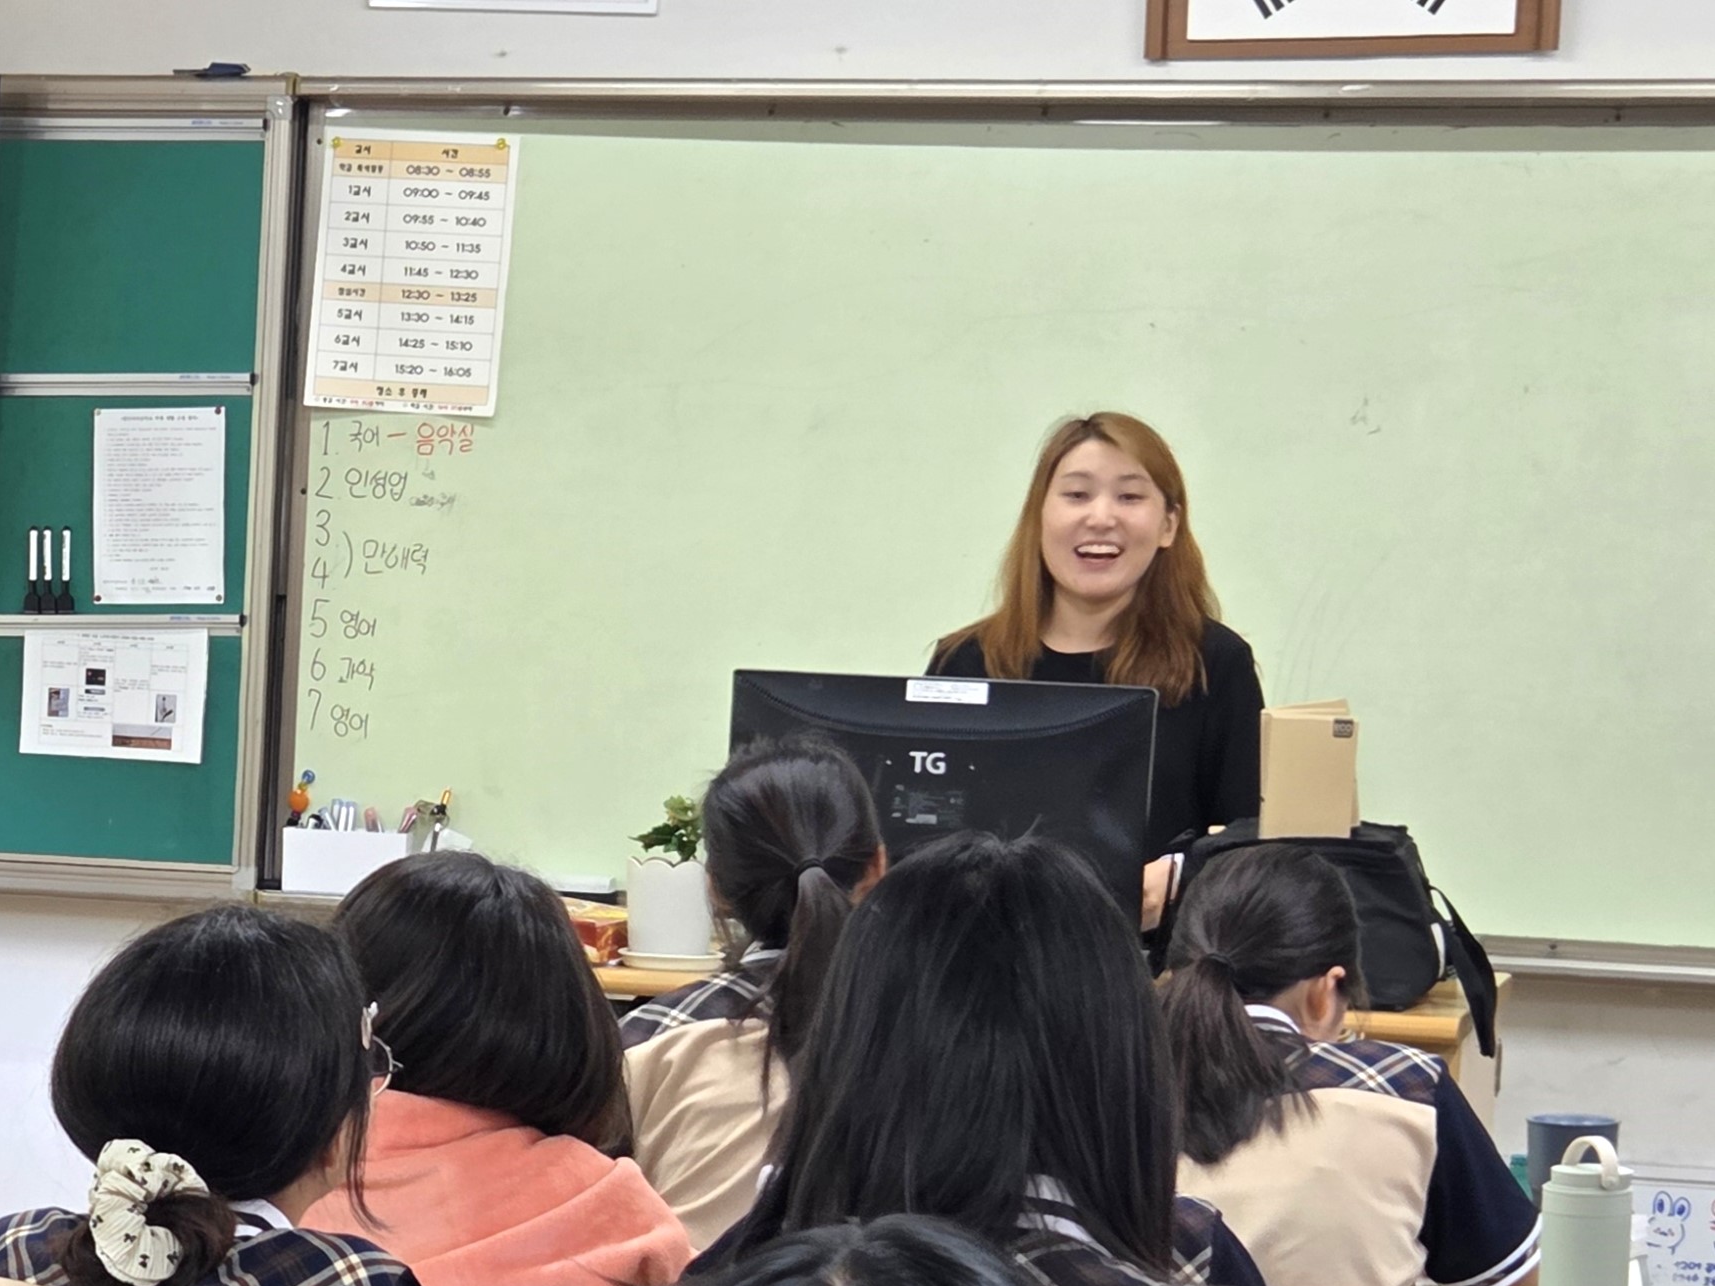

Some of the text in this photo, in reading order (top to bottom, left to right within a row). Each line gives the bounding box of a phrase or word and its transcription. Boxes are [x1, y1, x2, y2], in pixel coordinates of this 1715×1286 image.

[354, 145, 371, 156] 교시
[406, 165, 440, 176] 08:30
[459, 167, 491, 178] 08:55
[348, 185, 371, 197] 1교시
[403, 187, 439, 198] 09:00
[458, 189, 490, 201] 09:45
[344, 211, 370, 224] 2교시
[403, 214, 434, 225] 09:55
[455, 216, 486, 227] 10:40
[342, 237, 368, 250] 3교시
[405, 240, 436, 251] 10:50
[456, 242, 481, 253] 11:35
[340, 264, 366, 276] 4교시
[404, 266, 429, 277] 11:45
[450, 268, 479, 280] 12:30
[401, 289, 431, 300] 12:30
[451, 291, 477, 303] 13:25
[337, 309, 363, 321] 5교시
[401, 311, 430, 323] 13:30
[450, 314, 475, 325] 14:15
[334, 334, 360, 346] 6교시
[399, 338, 425, 349] 14:25
[445, 340, 473, 351] 15:10
[333, 360, 358, 372] 7교시
[395, 364, 424, 375] 15:20
[444, 367, 472, 377] 16:05
[349, 420, 380, 453] 국어
[416, 422, 474, 456] 음악실
[310, 598, 377, 639] 5 영어
[311, 648, 327, 681] 6
[308, 688, 369, 739] 7 영어
[909, 751, 946, 774] TG
